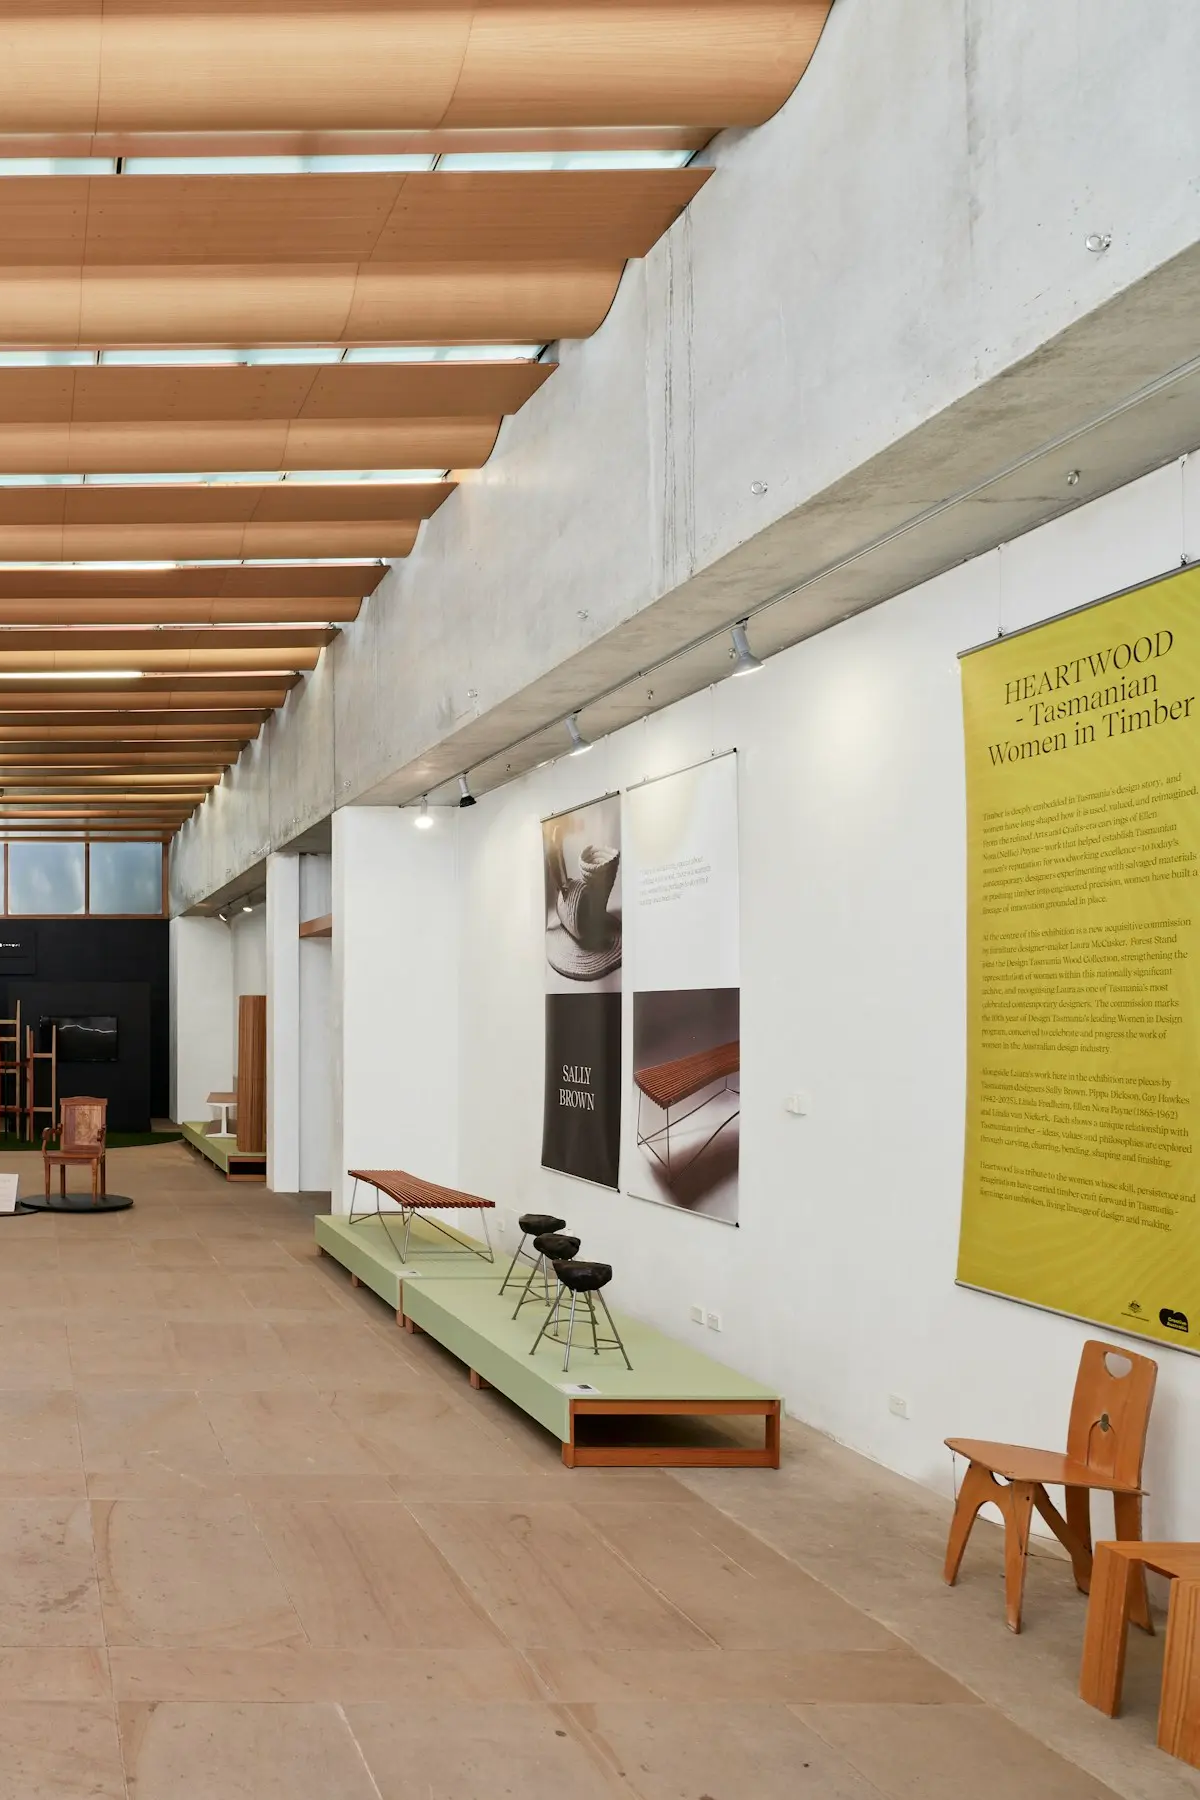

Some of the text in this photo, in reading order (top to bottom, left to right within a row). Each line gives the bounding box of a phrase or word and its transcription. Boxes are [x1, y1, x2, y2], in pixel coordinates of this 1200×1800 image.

[1004, 630, 1174, 706] HEARTWOOD
[1028, 673, 1158, 727] Tasmanian
[988, 696, 1196, 767] Women in Timber
[559, 1088, 595, 1111] BROWN
[562, 1064, 592, 1085] SALLY
